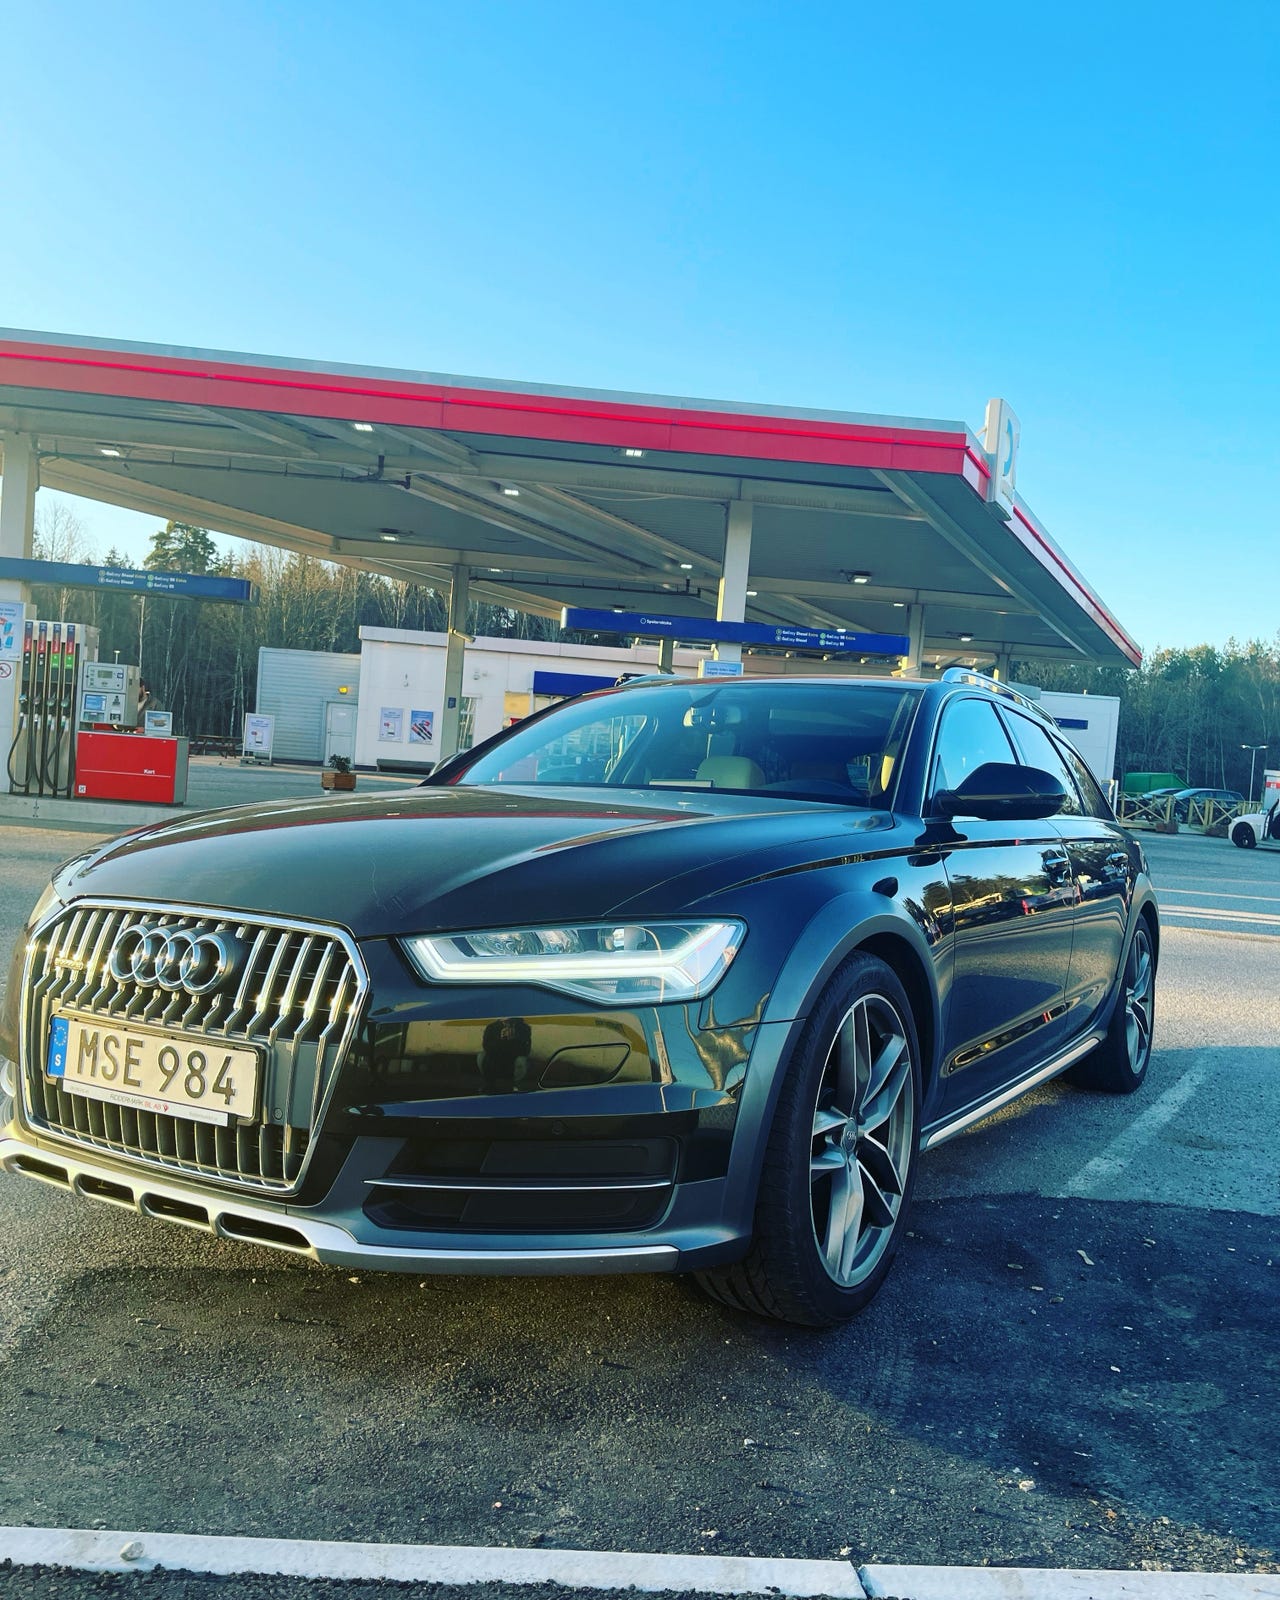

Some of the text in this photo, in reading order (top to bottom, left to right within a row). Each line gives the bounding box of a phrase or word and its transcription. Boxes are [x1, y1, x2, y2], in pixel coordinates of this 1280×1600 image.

[54, 1054, 61, 1067] S
[77, 1028, 236, 1106] MSE 984
